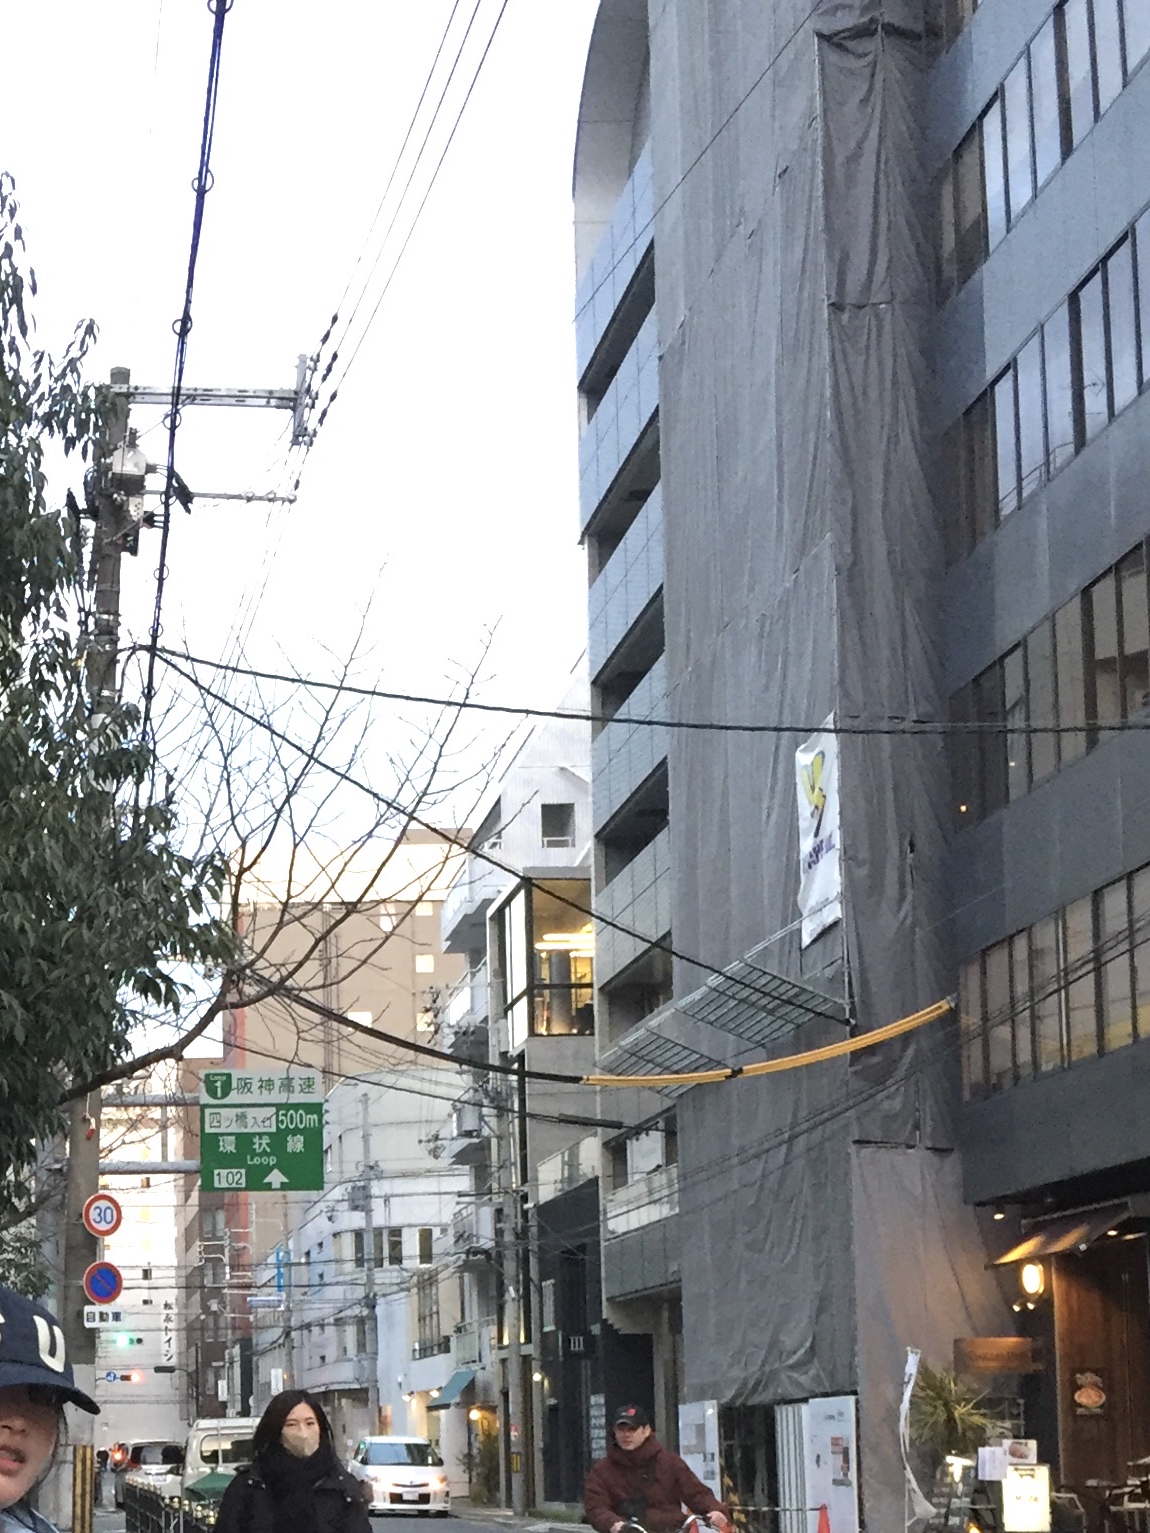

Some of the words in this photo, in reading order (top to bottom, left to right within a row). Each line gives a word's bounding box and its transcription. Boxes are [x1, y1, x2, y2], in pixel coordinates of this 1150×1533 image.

[214, 1080, 222, 1098] 1
[236, 1077, 315, 1095] 阪神高速
[278, 1109, 318, 1129] 500m
[218, 1135, 305, 1153] 環状線
[247, 1154, 277, 1166] Loop
[92, 1206, 114, 1225] 30
[86, 1311, 122, 1323] 自動車
